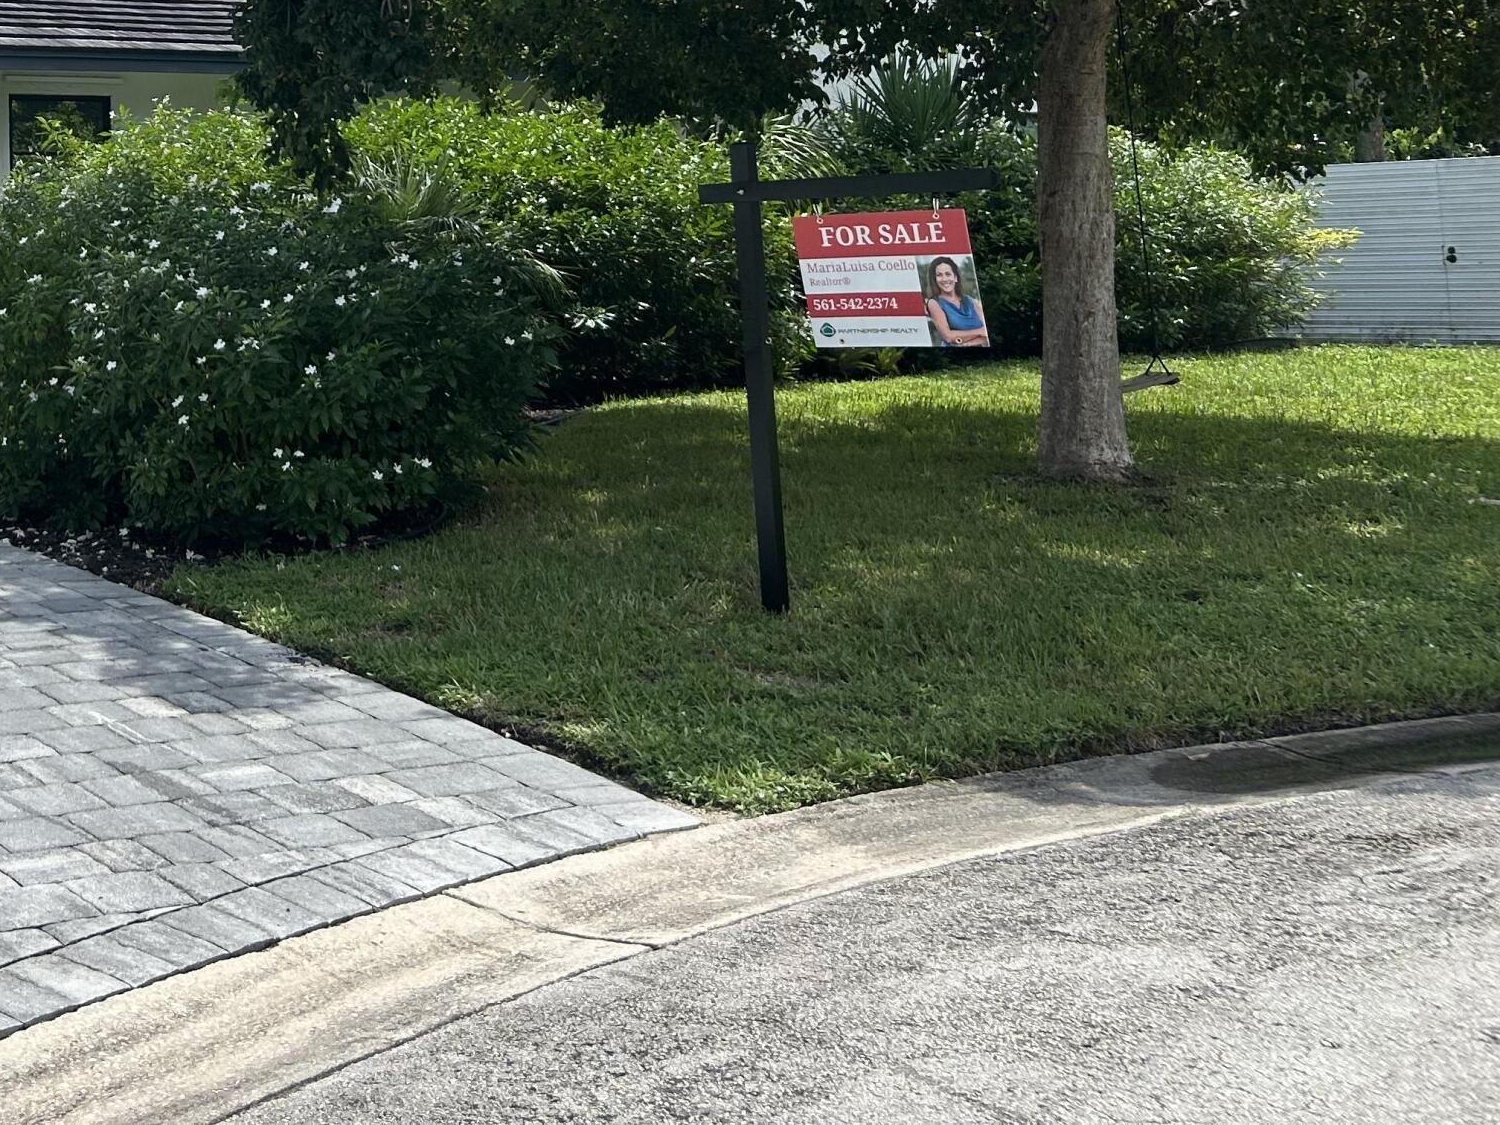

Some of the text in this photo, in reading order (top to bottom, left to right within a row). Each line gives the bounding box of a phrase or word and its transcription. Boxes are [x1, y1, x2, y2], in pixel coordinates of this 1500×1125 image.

[819, 222, 946, 247] FOR SALE
[807, 259, 915, 273] MariaLuisa Coello
[813, 297, 898, 311] 561-542-2374
